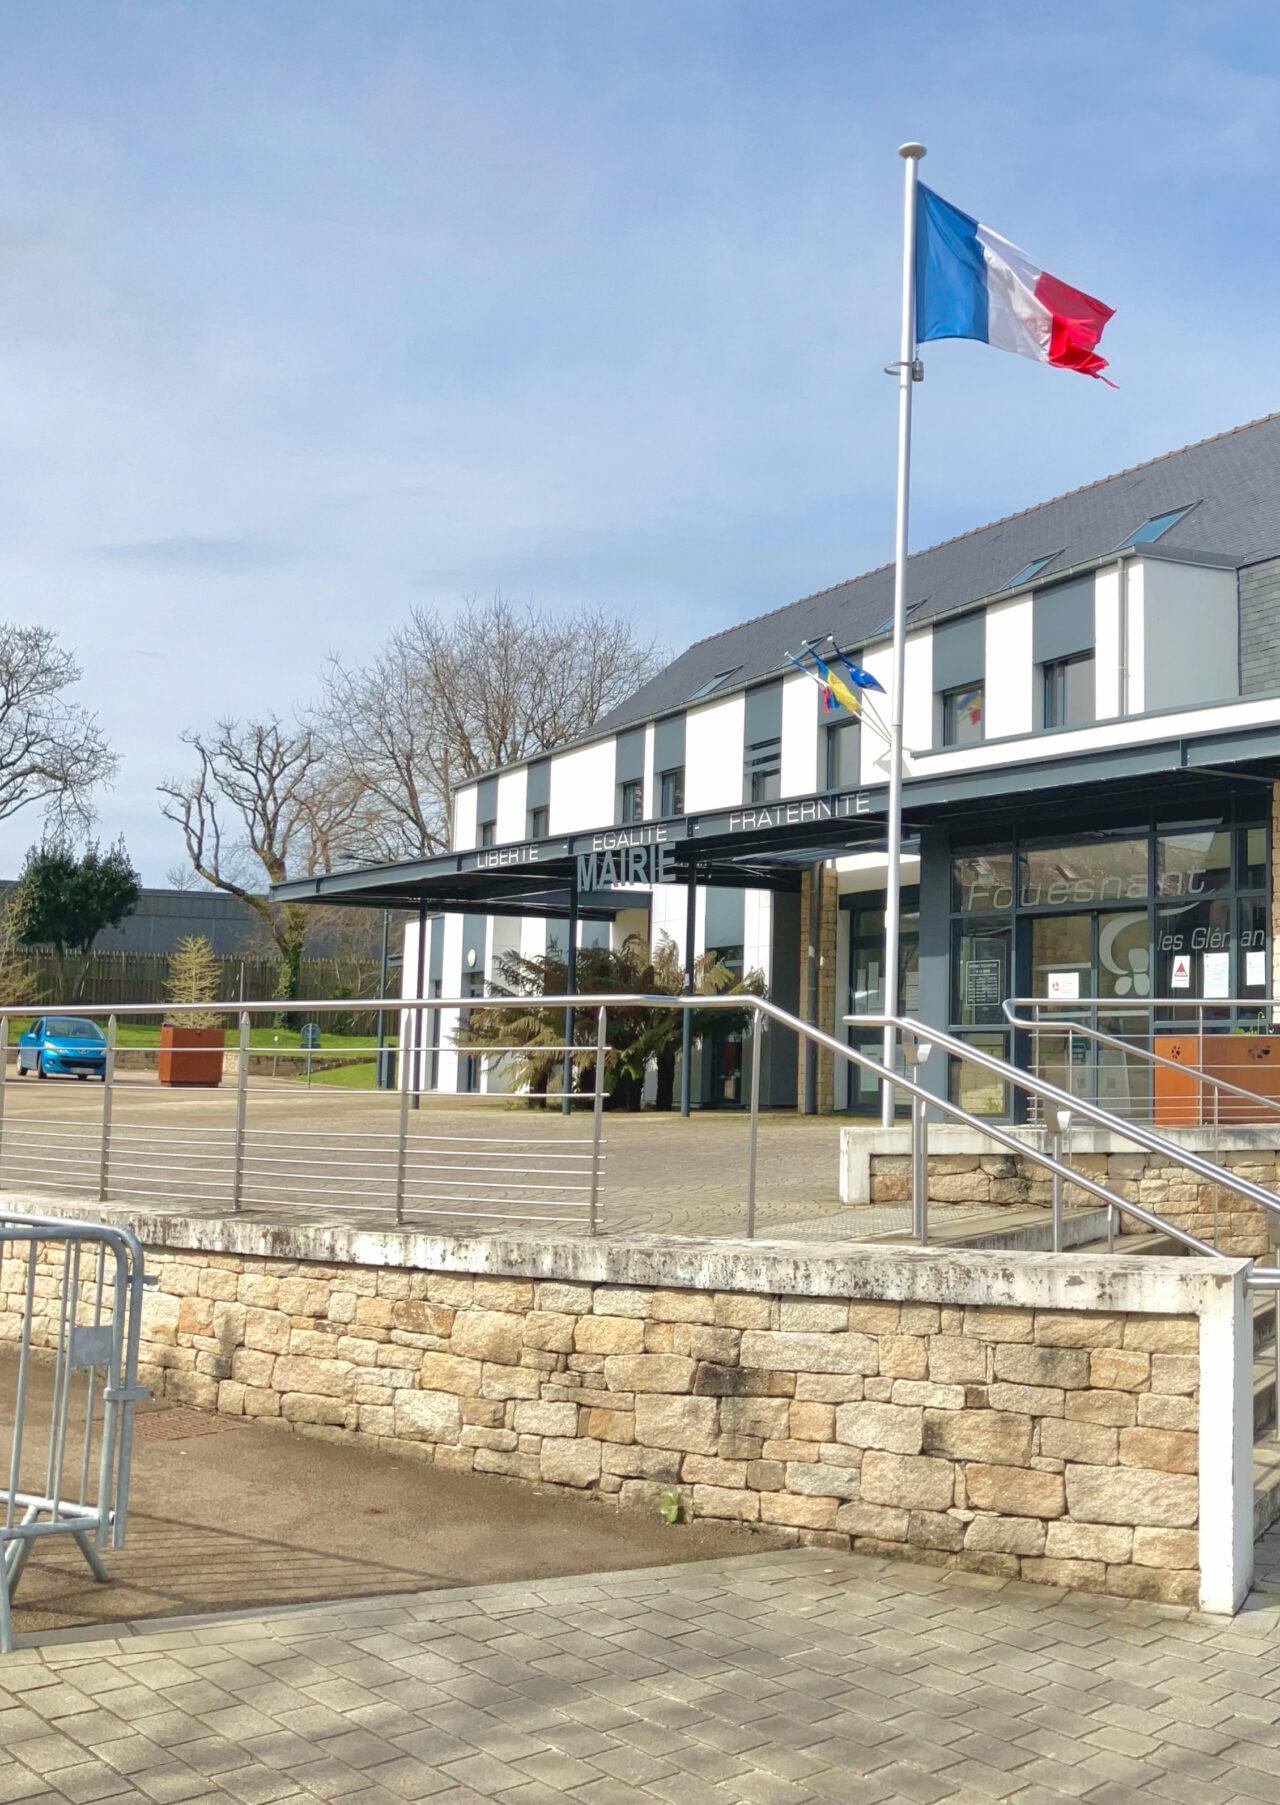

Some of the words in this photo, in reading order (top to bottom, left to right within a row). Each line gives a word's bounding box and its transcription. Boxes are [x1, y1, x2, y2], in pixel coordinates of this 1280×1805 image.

[577, 842, 676, 893] MAIRIE
[967, 867, 1206, 911] Fouesnant
[1157, 930, 1184, 951] les
